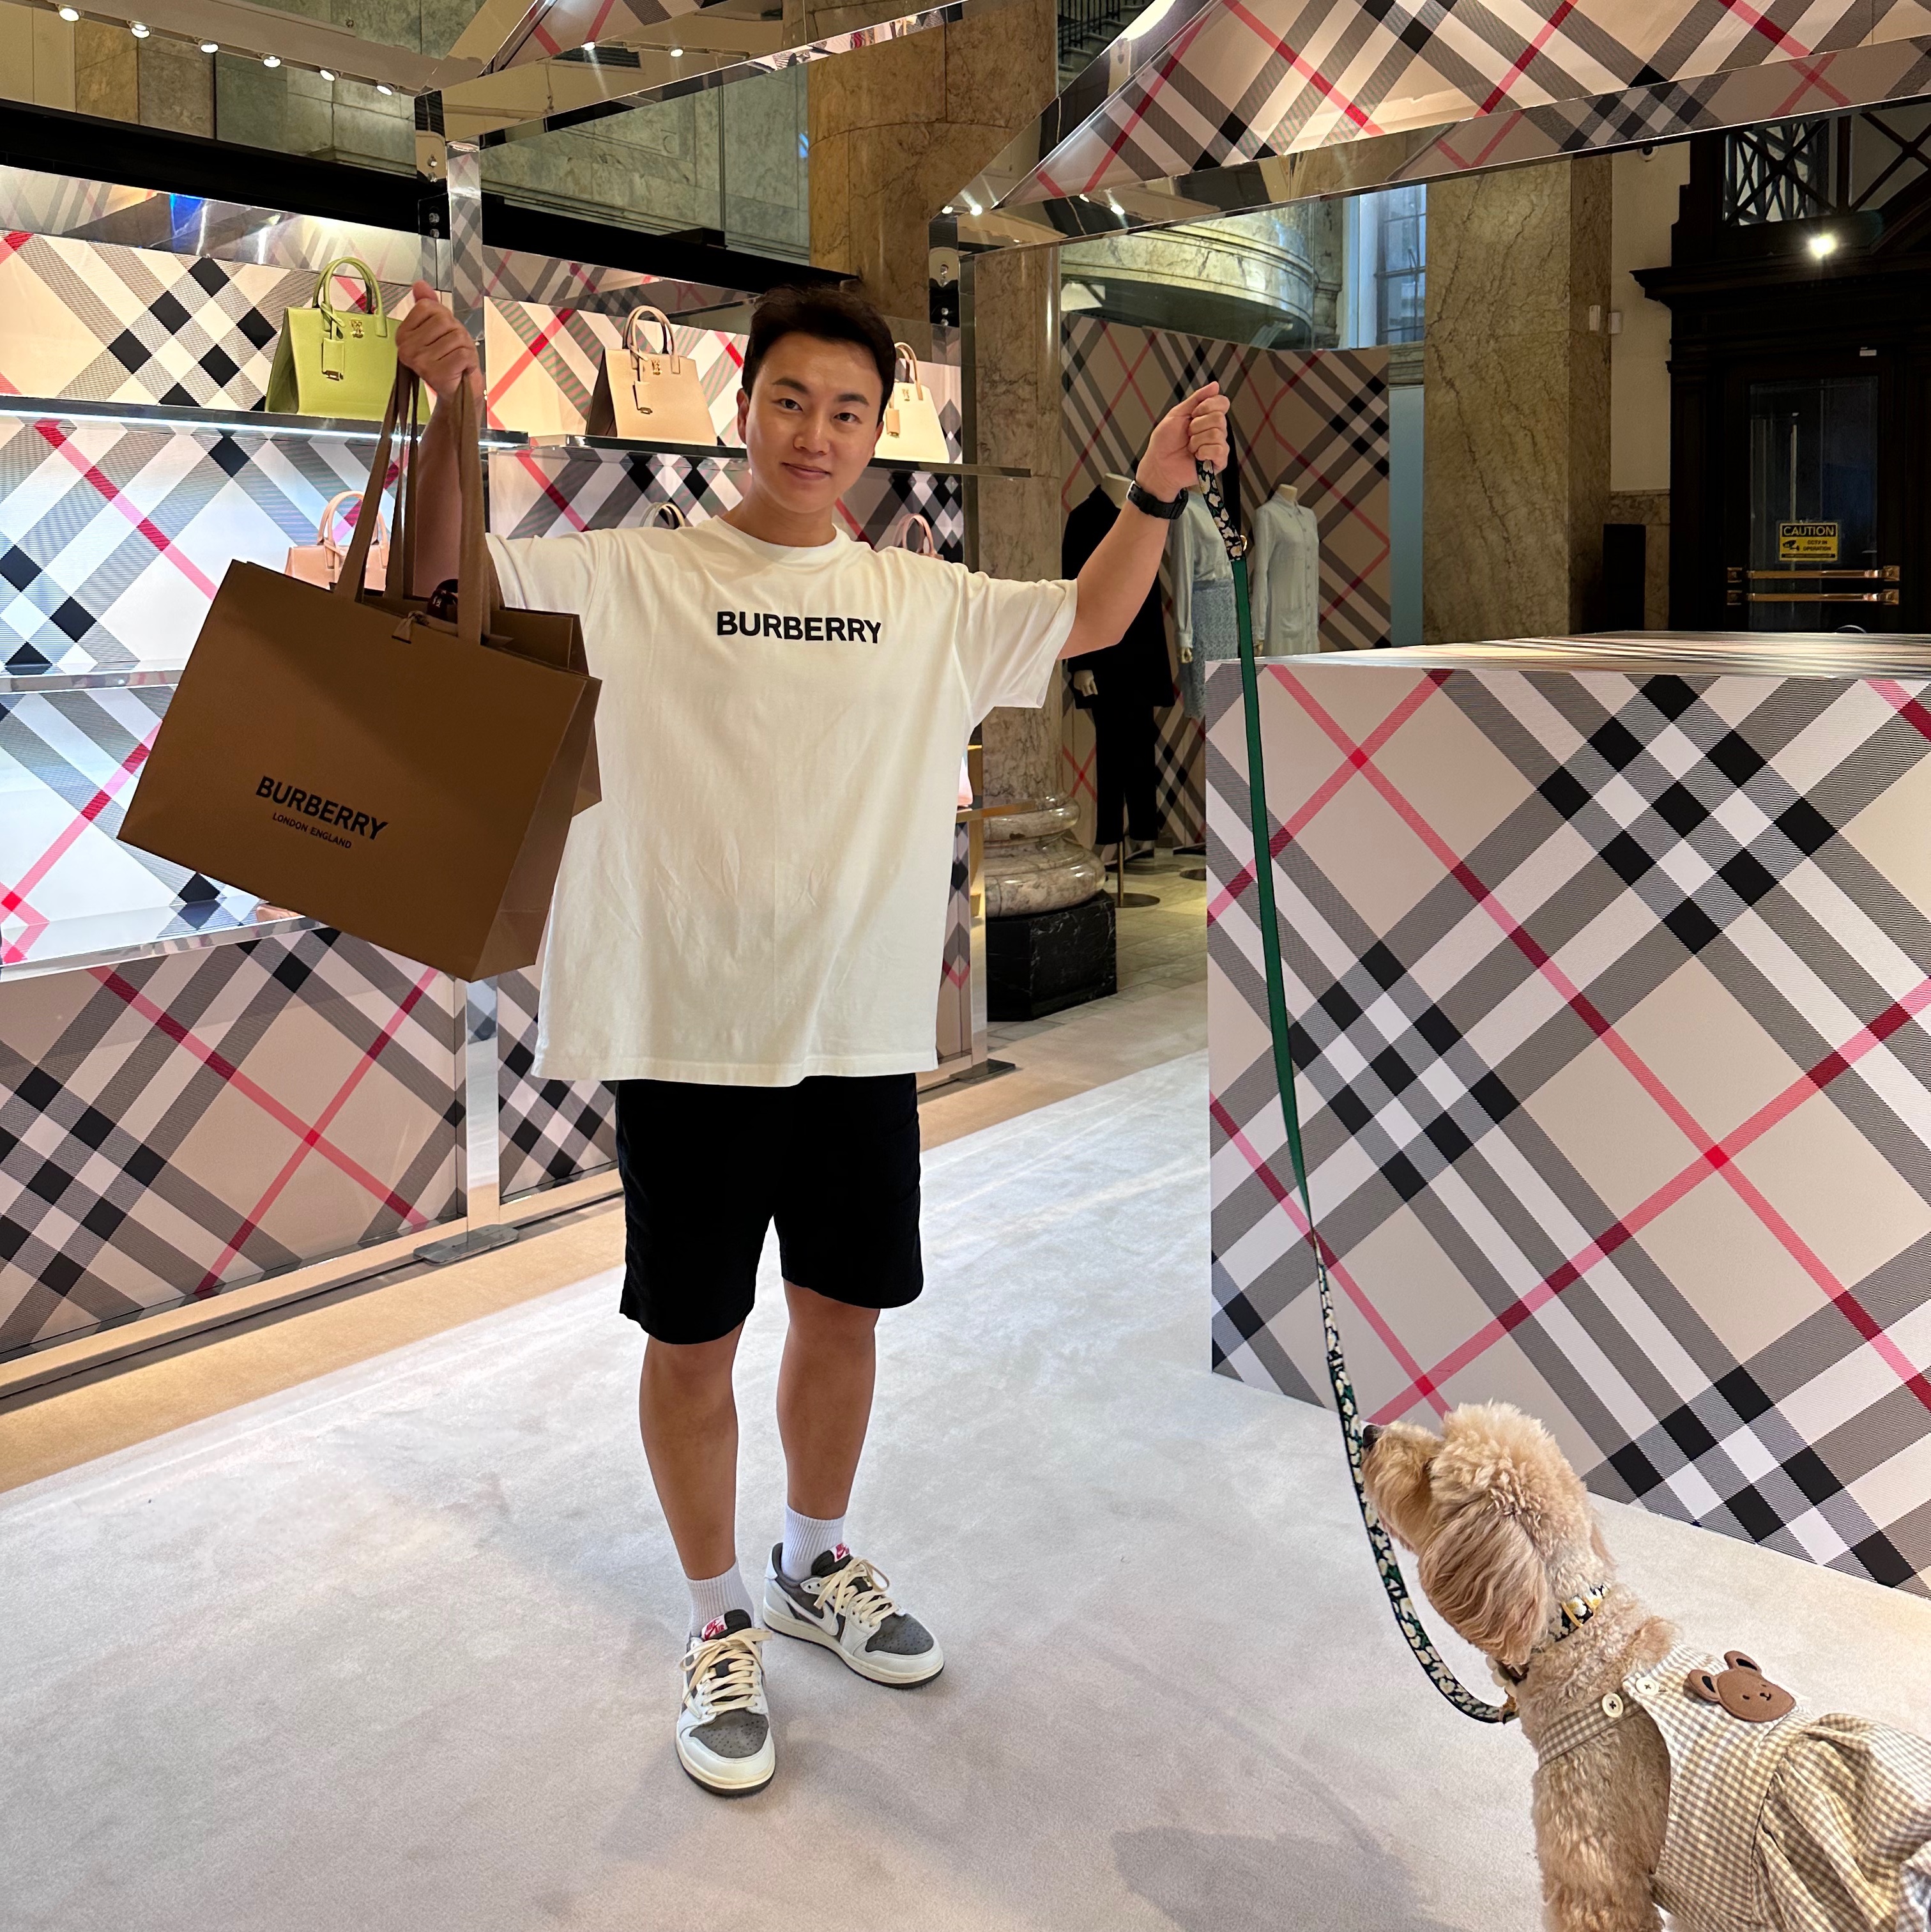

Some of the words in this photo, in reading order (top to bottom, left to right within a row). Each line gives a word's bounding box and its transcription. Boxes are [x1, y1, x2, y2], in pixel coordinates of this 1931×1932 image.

[1783, 526, 1834, 536] CAUTION
[717, 611, 882, 644] BURBERRY
[256, 775, 389, 840] BURBERRY
[272, 812, 309, 832] LONDON
[310, 827, 352, 849] ENGLAND
